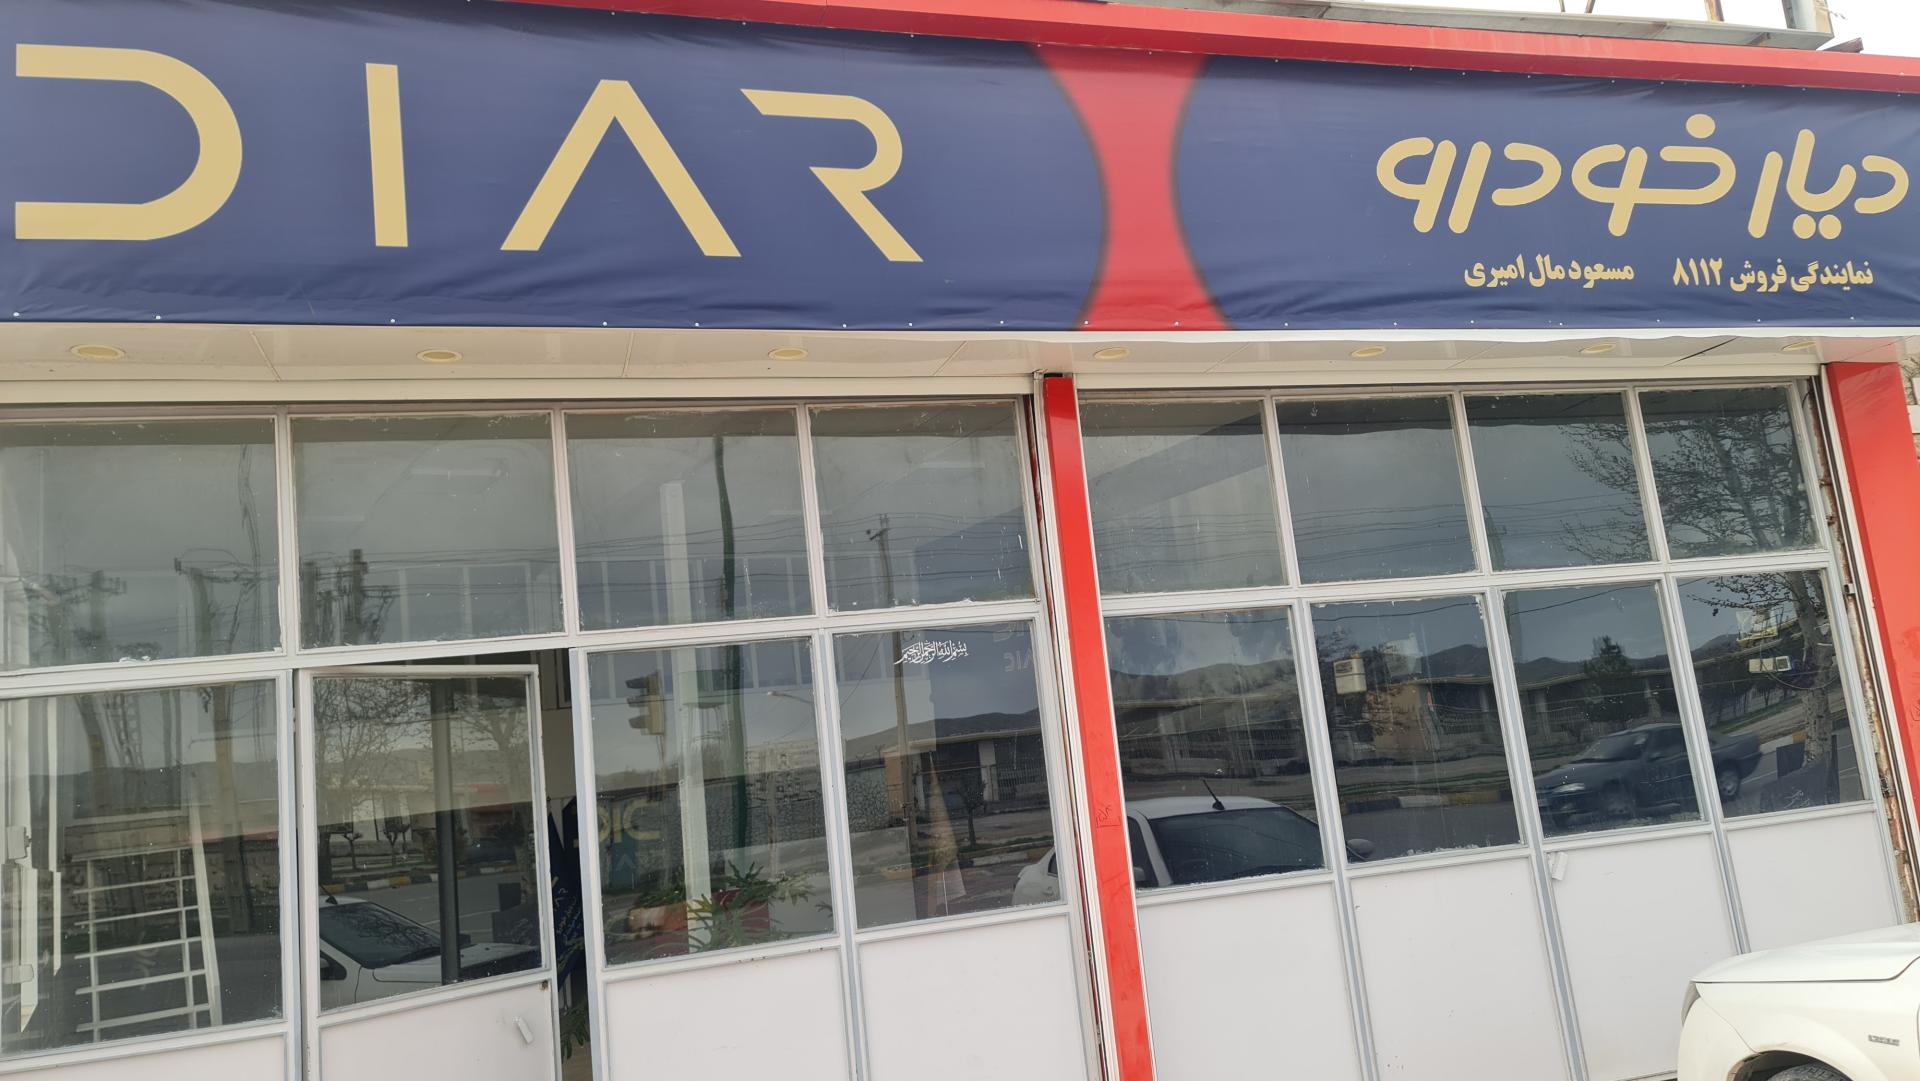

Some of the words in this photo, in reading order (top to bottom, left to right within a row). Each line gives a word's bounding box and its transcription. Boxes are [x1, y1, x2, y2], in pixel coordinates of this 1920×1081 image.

[15, 43, 922, 263] DIAR
[1376, 113, 1737, 237] خودرو
[1748, 128, 1910, 240] دیار
[1464, 253, 1525, 288] امیری
[1528, 253, 1566, 288] مال
[1567, 259, 1635, 289] مسعود
[1672, 257, 1723, 286] ۸۱۱۲
[1729, 257, 1788, 292] فروش
[1790, 260, 1874, 292] نمایندگی
